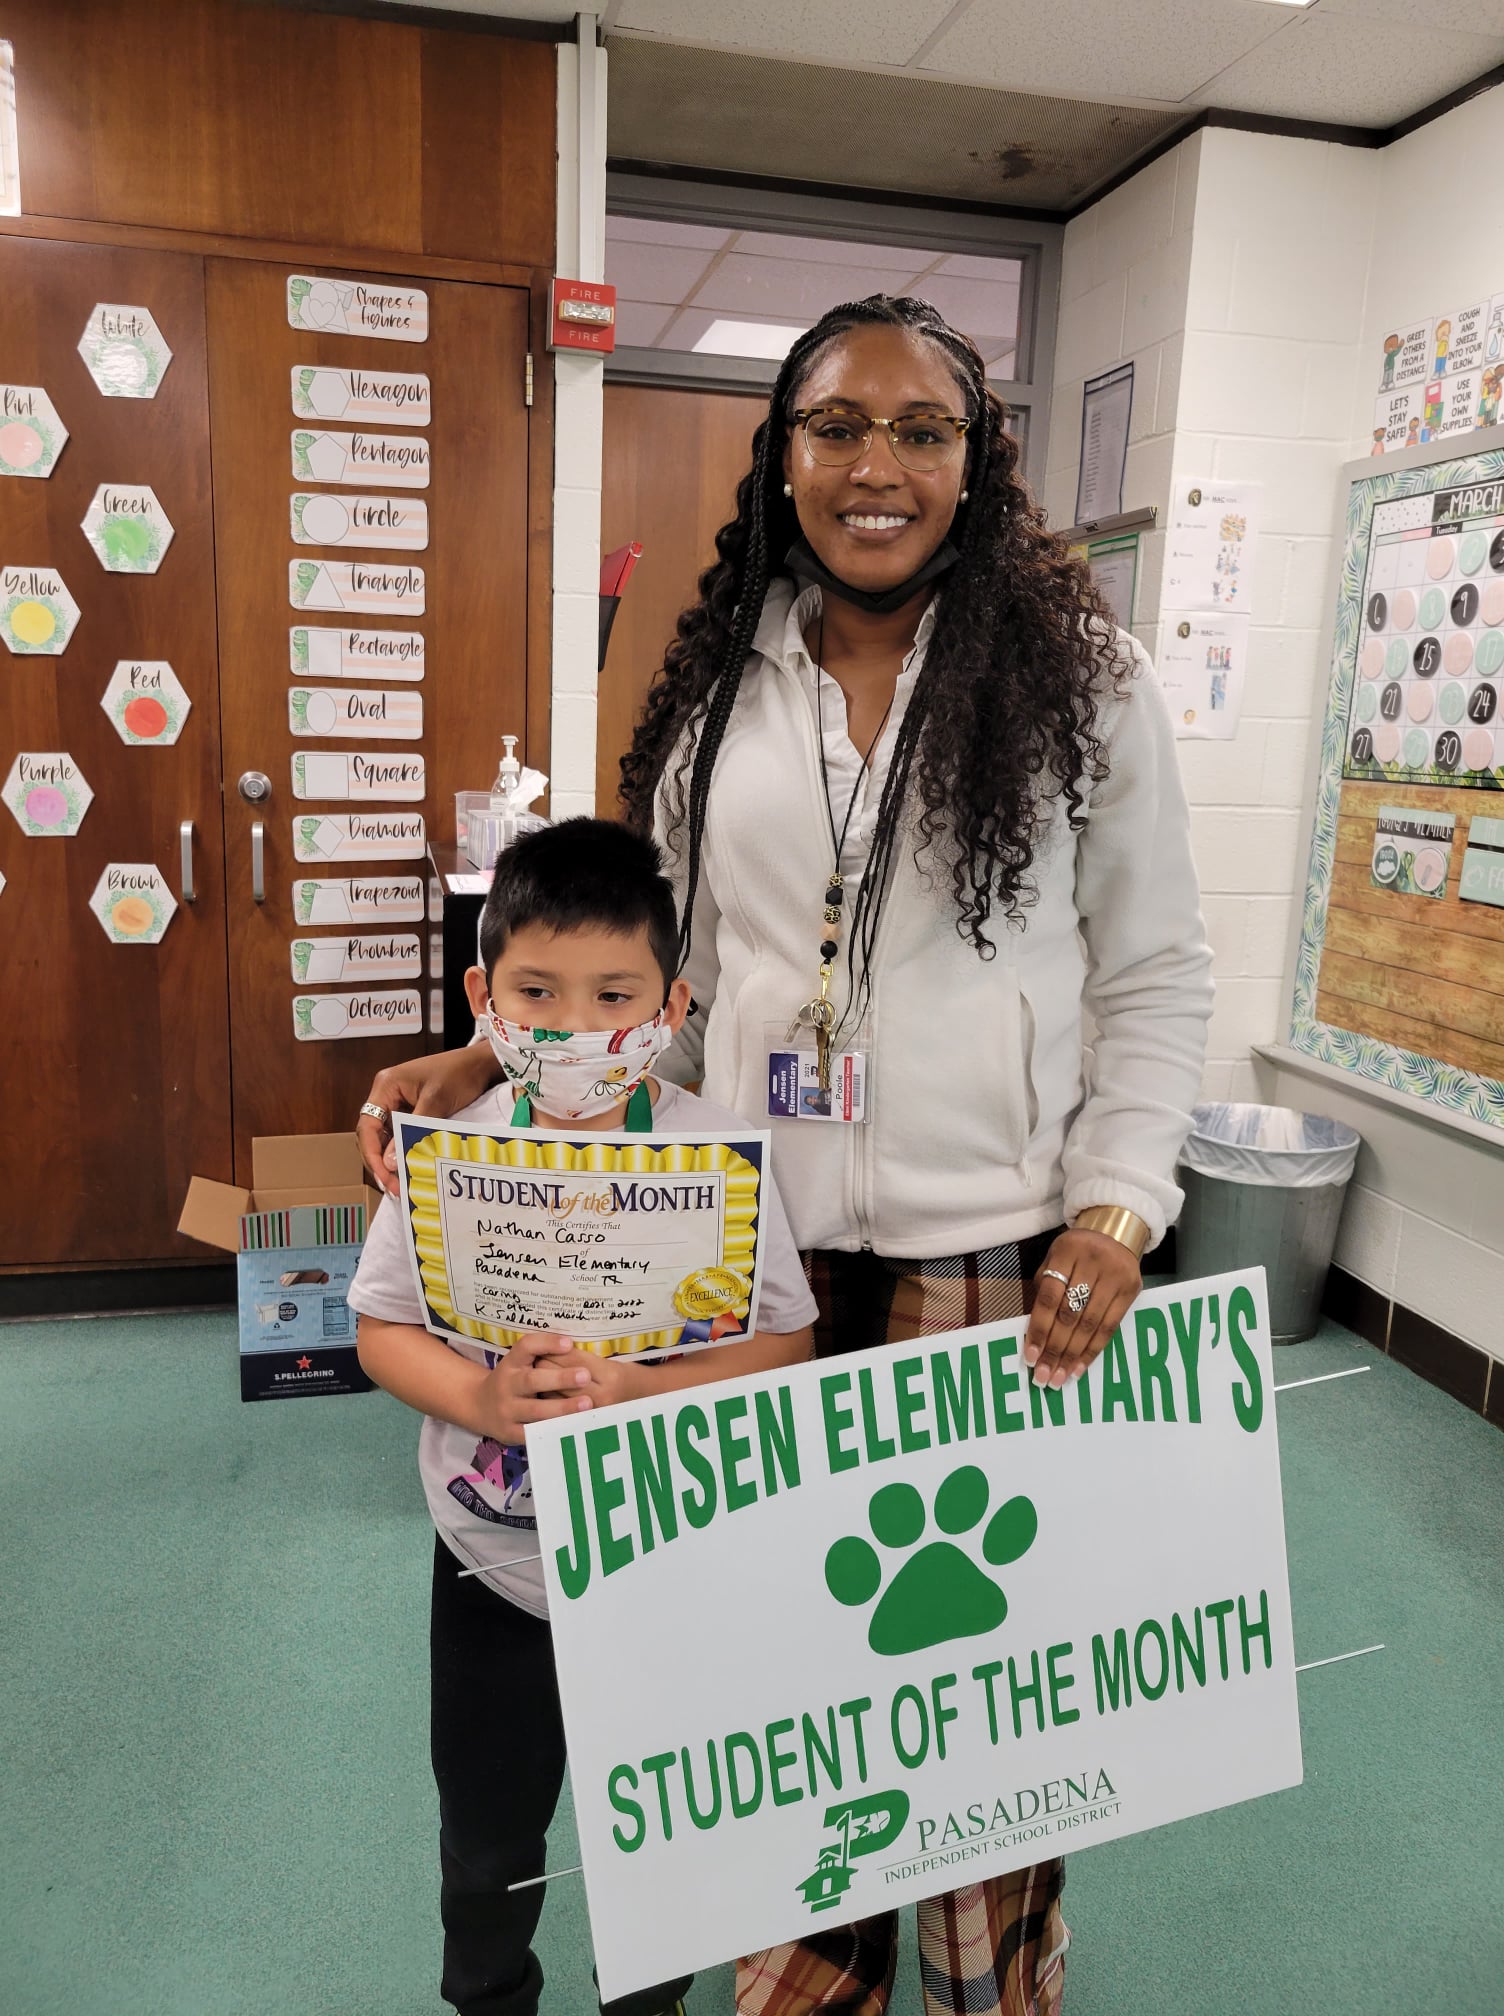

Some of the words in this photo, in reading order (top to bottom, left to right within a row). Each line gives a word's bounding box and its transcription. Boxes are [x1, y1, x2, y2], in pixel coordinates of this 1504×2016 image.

[357, 286, 402, 313] Shapes
[570, 287, 601, 300] FIRE
[101, 311, 150, 338] White
[1458, 307, 1481, 323] COUGH
[1461, 321, 1475, 334] AND
[569, 330, 600, 344] FIRE
[1402, 341, 1427, 357] OTHERS
[1406, 329, 1426, 344] GREET
[1455, 331, 1478, 347] SNEEZE
[1401, 356, 1419, 368] FROM
[1448, 348, 1464, 361] INTO
[1465, 342, 1482, 356] YOUR
[351, 371, 428, 407] Hexagon
[1457, 378, 1471, 390] USE
[4, 387, 36, 417] Pink
[1389, 395, 1409, 412] LET'S
[1451, 404, 1469, 418] OWN
[1452, 390, 1472, 406] YOUR
[1388, 411, 1408, 427] STAY
[1386, 426, 1407, 443] SAFE!
[352, 432, 429, 469] Pentagon
[103, 488, 153, 514] Green
[353, 498, 408, 528] Circle
[1449, 485, 1503, 518] MARCH
[4, 572, 61, 597] Yellow
[344, 562, 426, 600] Triangle
[1460, 591, 1468, 618] 9
[348, 632, 425, 661] Rectangle
[1419, 642, 1436, 671] 15
[130, 665, 162, 689] Red
[347, 692, 386, 720] Oval
[1383, 688, 1398, 715] 21
[1472, 689, 1491, 717] 24
[1355, 734, 1370, 759] 27
[1438, 736, 1458, 765] 30
[19, 755, 77, 784] Purple
[353, 755, 426, 788] Square
[349, 814, 422, 840] Diamond
[107, 869, 160, 891] Brown
[344, 879, 421, 907] Trapezoid
[348, 938, 419, 962] Rhombus
[349, 996, 417, 1021] Octagon
[779, 1070, 787, 1104] Jensen
[788, 1061, 798, 1114] Elementary
[835, 1074, 843, 1100] Poole
[448, 1169, 565, 1210] STUDENT
[550, 1191, 584, 1220] of
[583, 1190, 619, 1217] the
[610, 1182, 715, 1212] MONTH
[477, 1219, 546, 1240] Nathan
[555, 1228, 606, 1244] Casso
[546, 1220, 564, 1228] This
[566, 1221, 600, 1230] Certifies
[601, 1222, 621, 1230] That
[479, 1242, 547, 1266] Jensen
[559, 1254, 650, 1274] Elementary
[580, 1248, 590, 1257] of
[475, 1258, 545, 1283] Pasadena
[570, 1273, 598, 1282] School
[690, 1286, 733, 1303] EXCELLENCE
[274, 1369, 335, 1381] S.PELLEGRINO
[555, 1385, 801, 1600] JENSEN
[607, 1697, 872, 1853] STUDENT
[891, 1673, 959, 1769] OF
[972, 1642, 1080, 1745] THE
[1092, 1591, 1273, 1713] MONTH
[916, 1767, 1118, 1852] PASADENA
[884, 1841, 990, 1884] INDEPENDENT
[993, 1823, 1053, 1850] SCHOOL
[1057, 1801, 1123, 1832] DISTRICT
